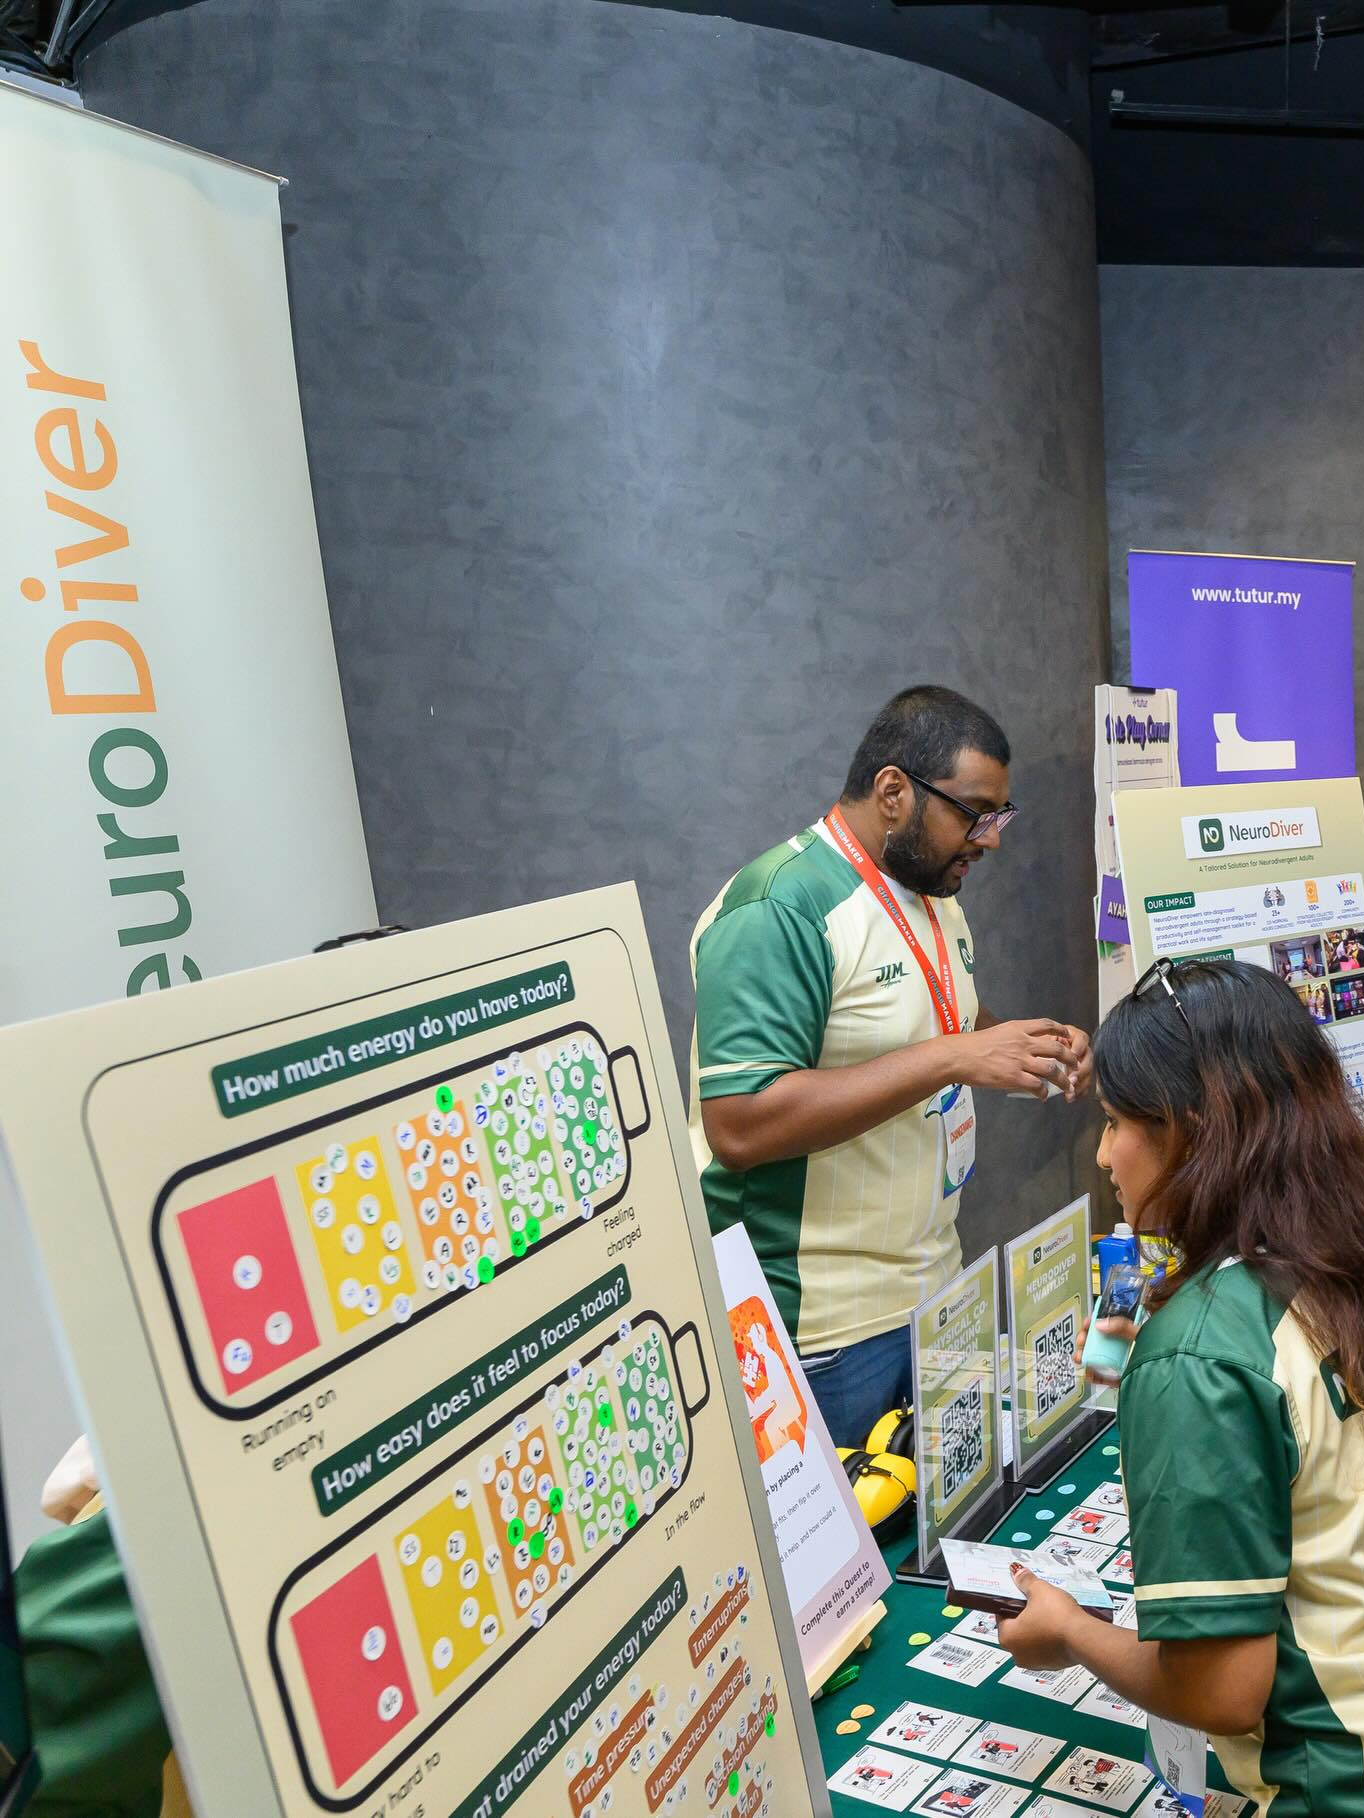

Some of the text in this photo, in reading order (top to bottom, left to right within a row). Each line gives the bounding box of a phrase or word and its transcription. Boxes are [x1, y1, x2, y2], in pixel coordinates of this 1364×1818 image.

[1191, 585, 1302, 610] www.tutur.my
[18, 338, 202, 997] euroDiver
[1229, 820, 1304, 841] NeuroDiver
[1204, 862, 1227, 872] Tailored
[1228, 861, 1249, 870] Solution
[1259, 856, 1298, 867] Neurodivergent
[1147, 896, 1192, 910] OUR IMPACT
[868, 962, 911, 983] JIM
[223, 974, 568, 1103] How much energy do you have today?
[603, 1206, 635, 1232] Feeling
[607, 1224, 642, 1257] charged
[1026, 1253, 1077, 1296] NEURODIVER
[1033, 1269, 1070, 1304] WAITLIST
[321, 1277, 625, 1501] How easy does it feel to focus today?
[241, 1387, 337, 1454] Running on
[272, 1428, 325, 1472] empty
[770, 1482, 778, 1493] by
[778, 1464, 800, 1488] placing
[665, 1493, 707, 1542] In the flow
[787, 1503, 799, 1516] then
[800, 1532, 810, 1544] and
[809, 1522, 820, 1535] how
[820, 1510, 833, 1525] could
[801, 1561, 870, 1636] Complete this Quest to
[836, 1572, 876, 1619] earn a stamp!
[692, 1584, 749, 1658] Interruptions
[495, 1580, 682, 1802] drained your energy today?
[574, 1709, 648, 1804] Time pressur
[651, 1670, 743, 1800] Unexpected changes
[388, 1752, 441, 1809] hard to
